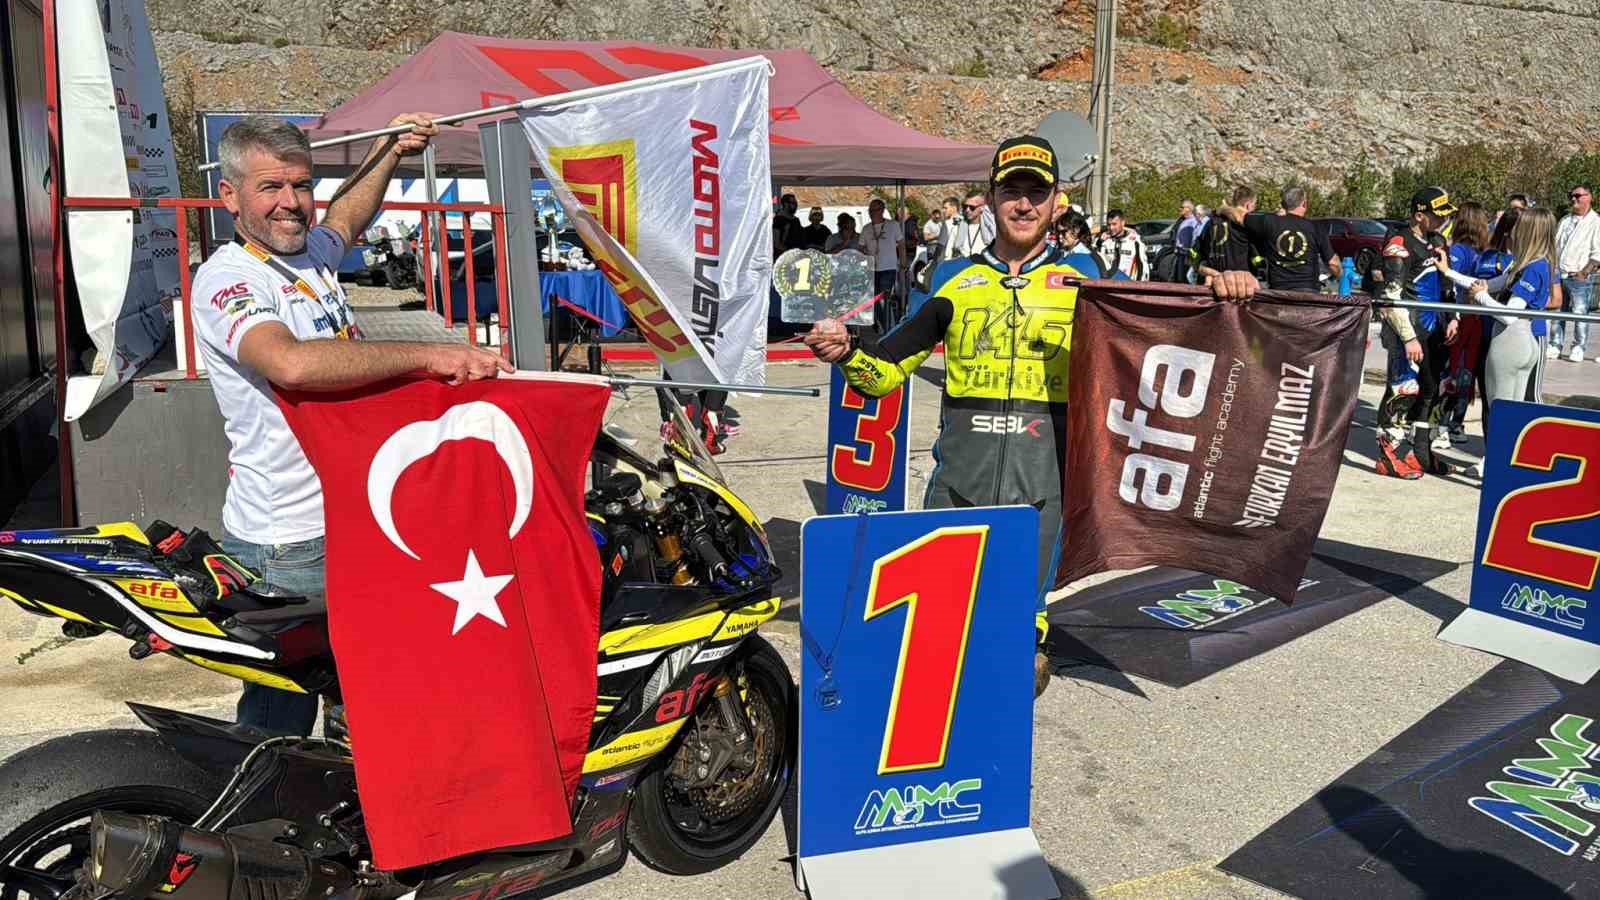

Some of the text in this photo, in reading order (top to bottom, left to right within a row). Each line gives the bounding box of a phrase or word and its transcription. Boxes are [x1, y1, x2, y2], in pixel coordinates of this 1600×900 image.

[793, 256, 813, 292] 1
[959, 306, 1076, 361] 145
[960, 365, 1064, 396] Türkiye
[832, 382, 904, 491] 3
[971, 415, 1045, 437] SBK
[1106, 344, 1216, 512] afa
[1194, 358, 1245, 519] atlantic flight academy
[1242, 362, 1315, 525] FURKAN ERYILMAZ
[1481, 416, 1600, 590] 2
[129, 582, 178, 599] afa
[726, 620, 759, 633] YAMAHA
[864, 524, 990, 775] 1
